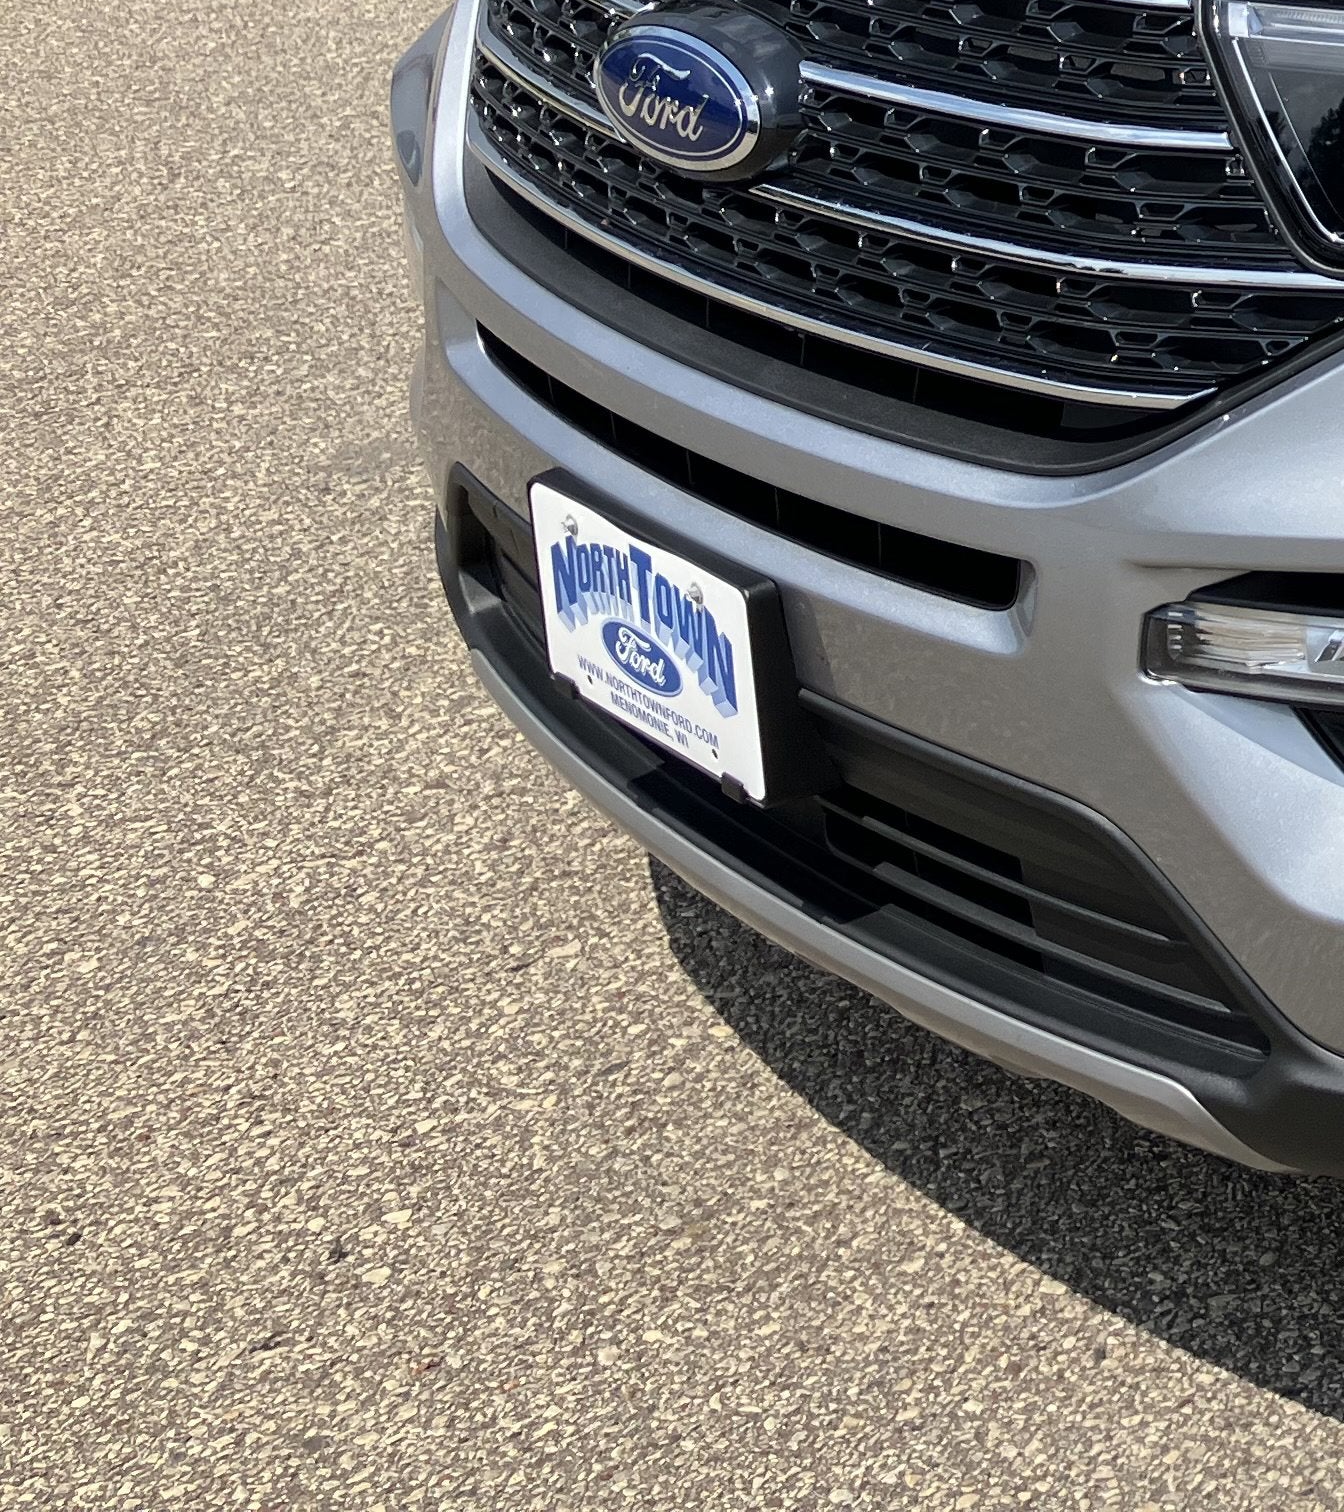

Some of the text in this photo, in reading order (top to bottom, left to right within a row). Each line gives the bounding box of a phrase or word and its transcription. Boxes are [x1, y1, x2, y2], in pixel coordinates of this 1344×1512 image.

[618, 52, 710, 142] Ford
[615, 626, 667, 687] Ford
[577, 655, 720, 749] WWW.NORTHTOWNFORD.COM
[675, 730, 689, 750] WI
